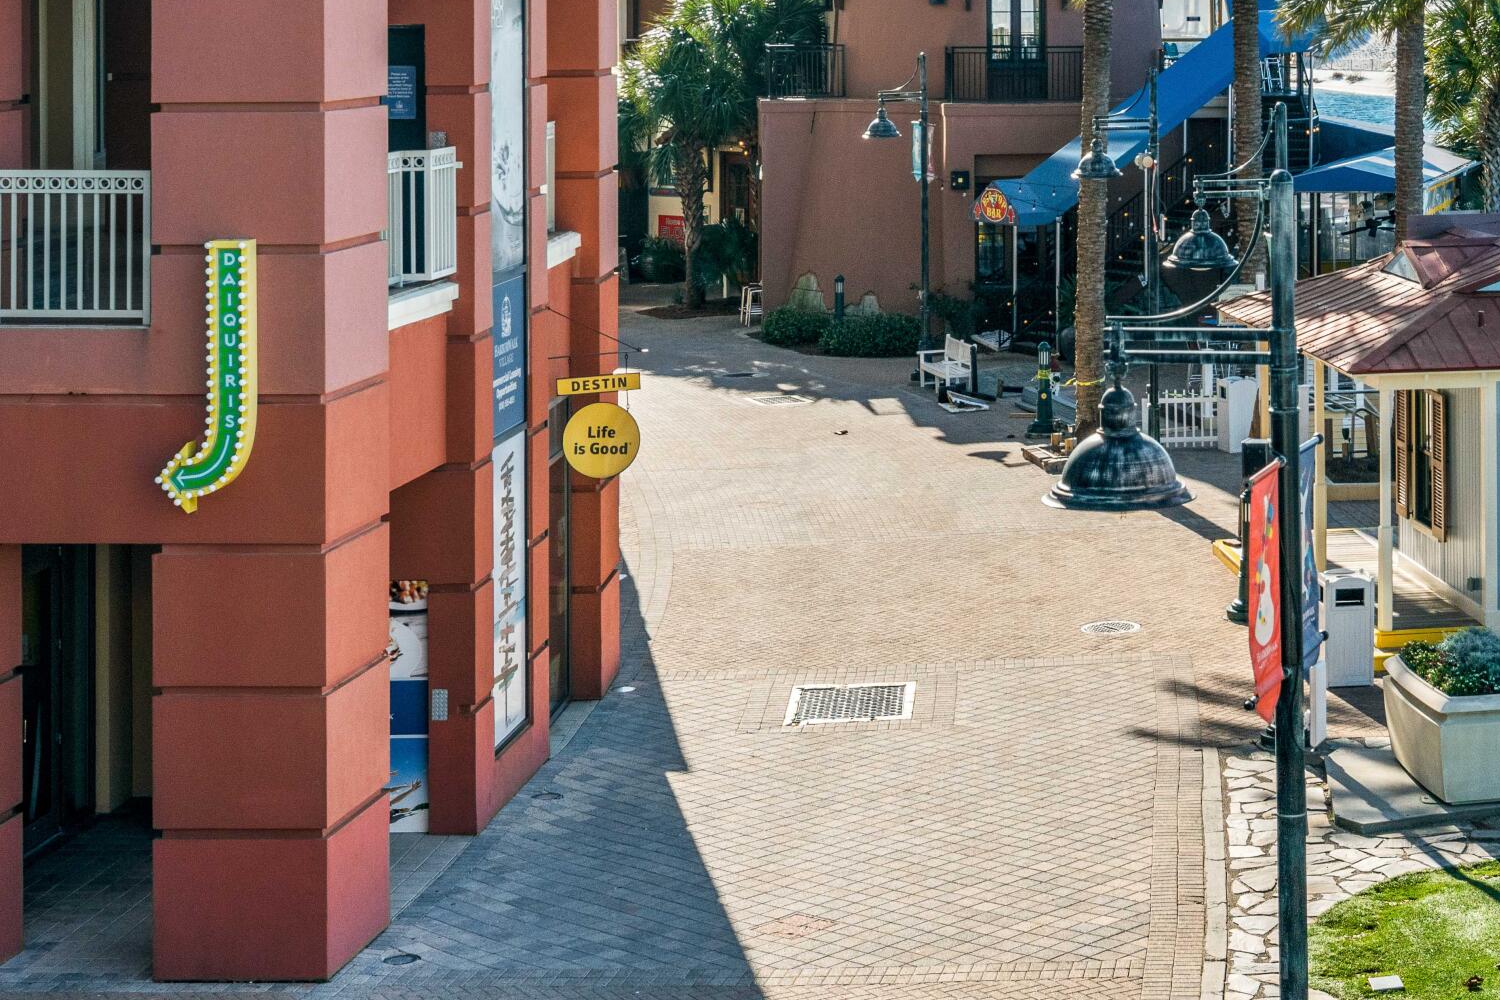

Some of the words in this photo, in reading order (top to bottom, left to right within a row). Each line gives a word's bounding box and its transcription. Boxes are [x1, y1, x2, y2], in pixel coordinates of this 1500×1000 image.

[987, 206, 1001, 218] BAR
[222, 252, 236, 428] DAIQUIRIS
[571, 376, 627, 392] DESTIN
[588, 426, 616, 439] Life
[574, 442, 585, 455] is
[590, 442, 628, 455] Good
